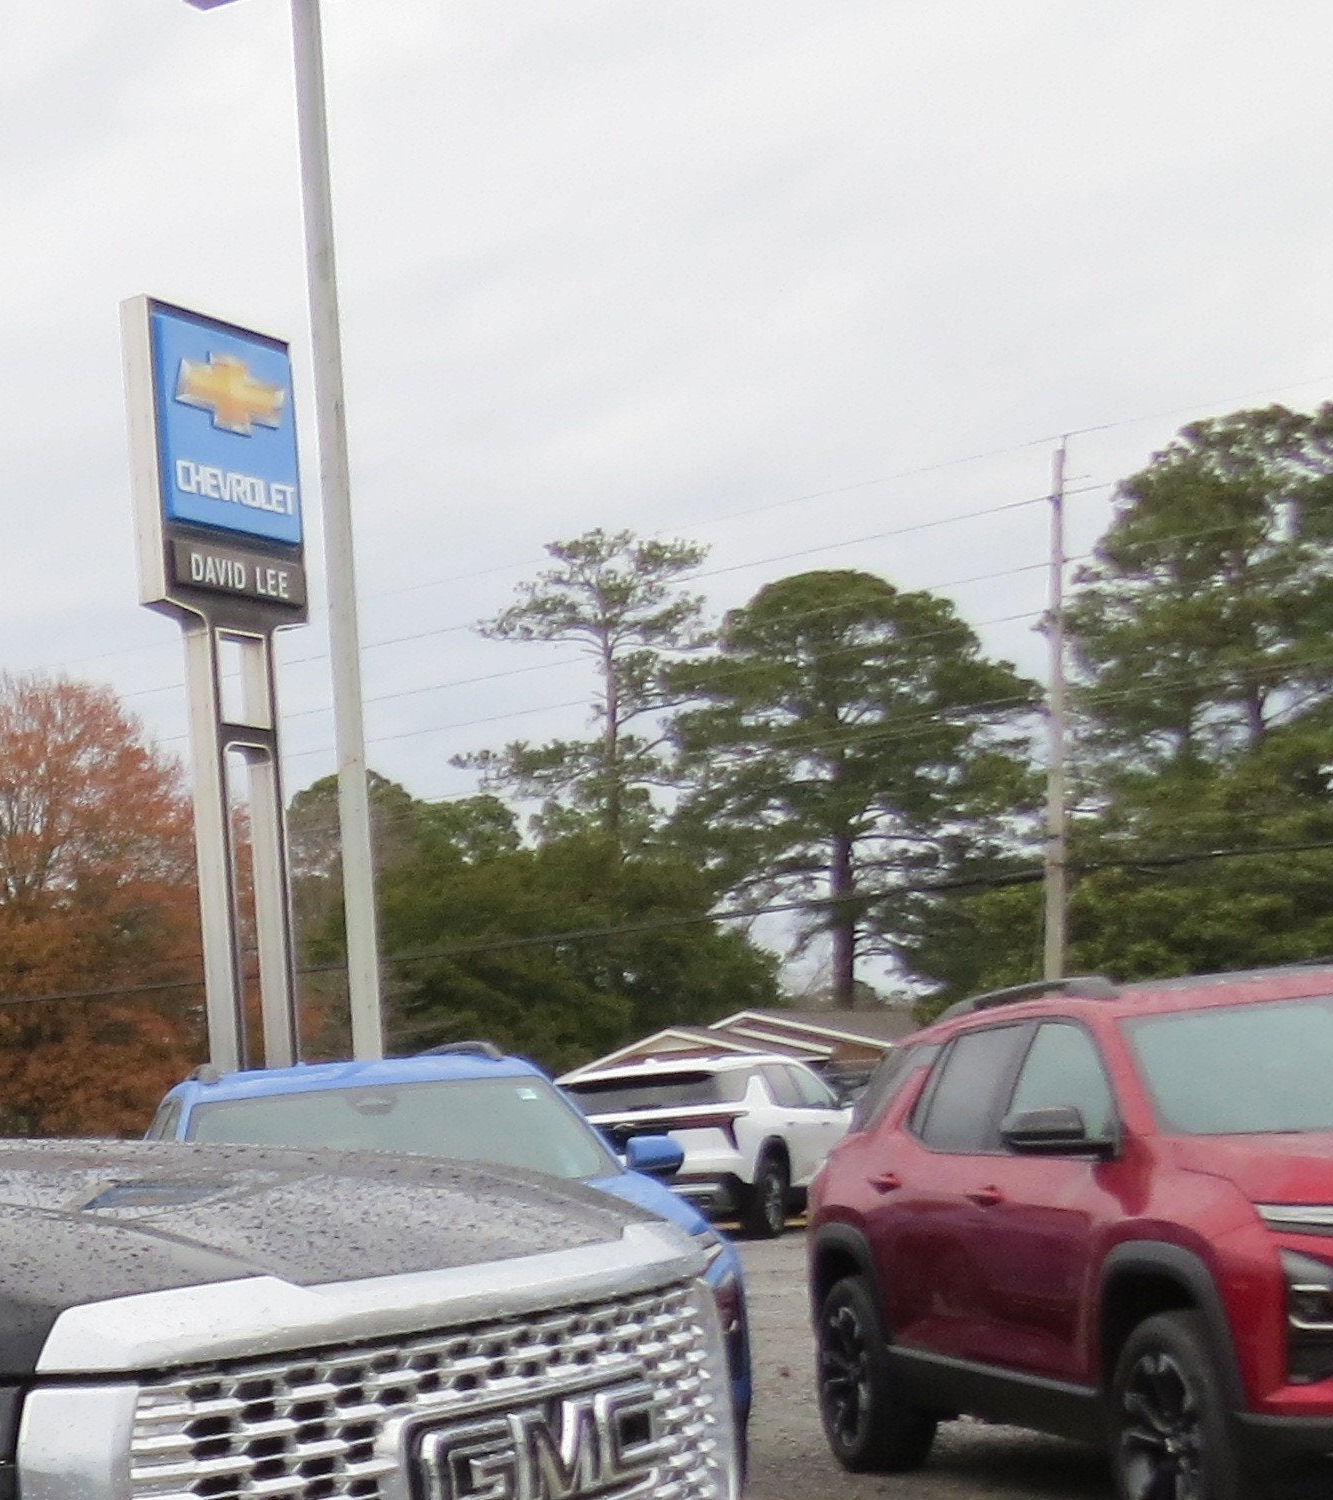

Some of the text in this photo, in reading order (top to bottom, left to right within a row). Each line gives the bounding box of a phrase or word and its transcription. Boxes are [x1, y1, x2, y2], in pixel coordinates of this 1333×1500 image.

[175, 459, 294, 515] CHEVROLET
[191, 552, 288, 599] DAVID LEE
